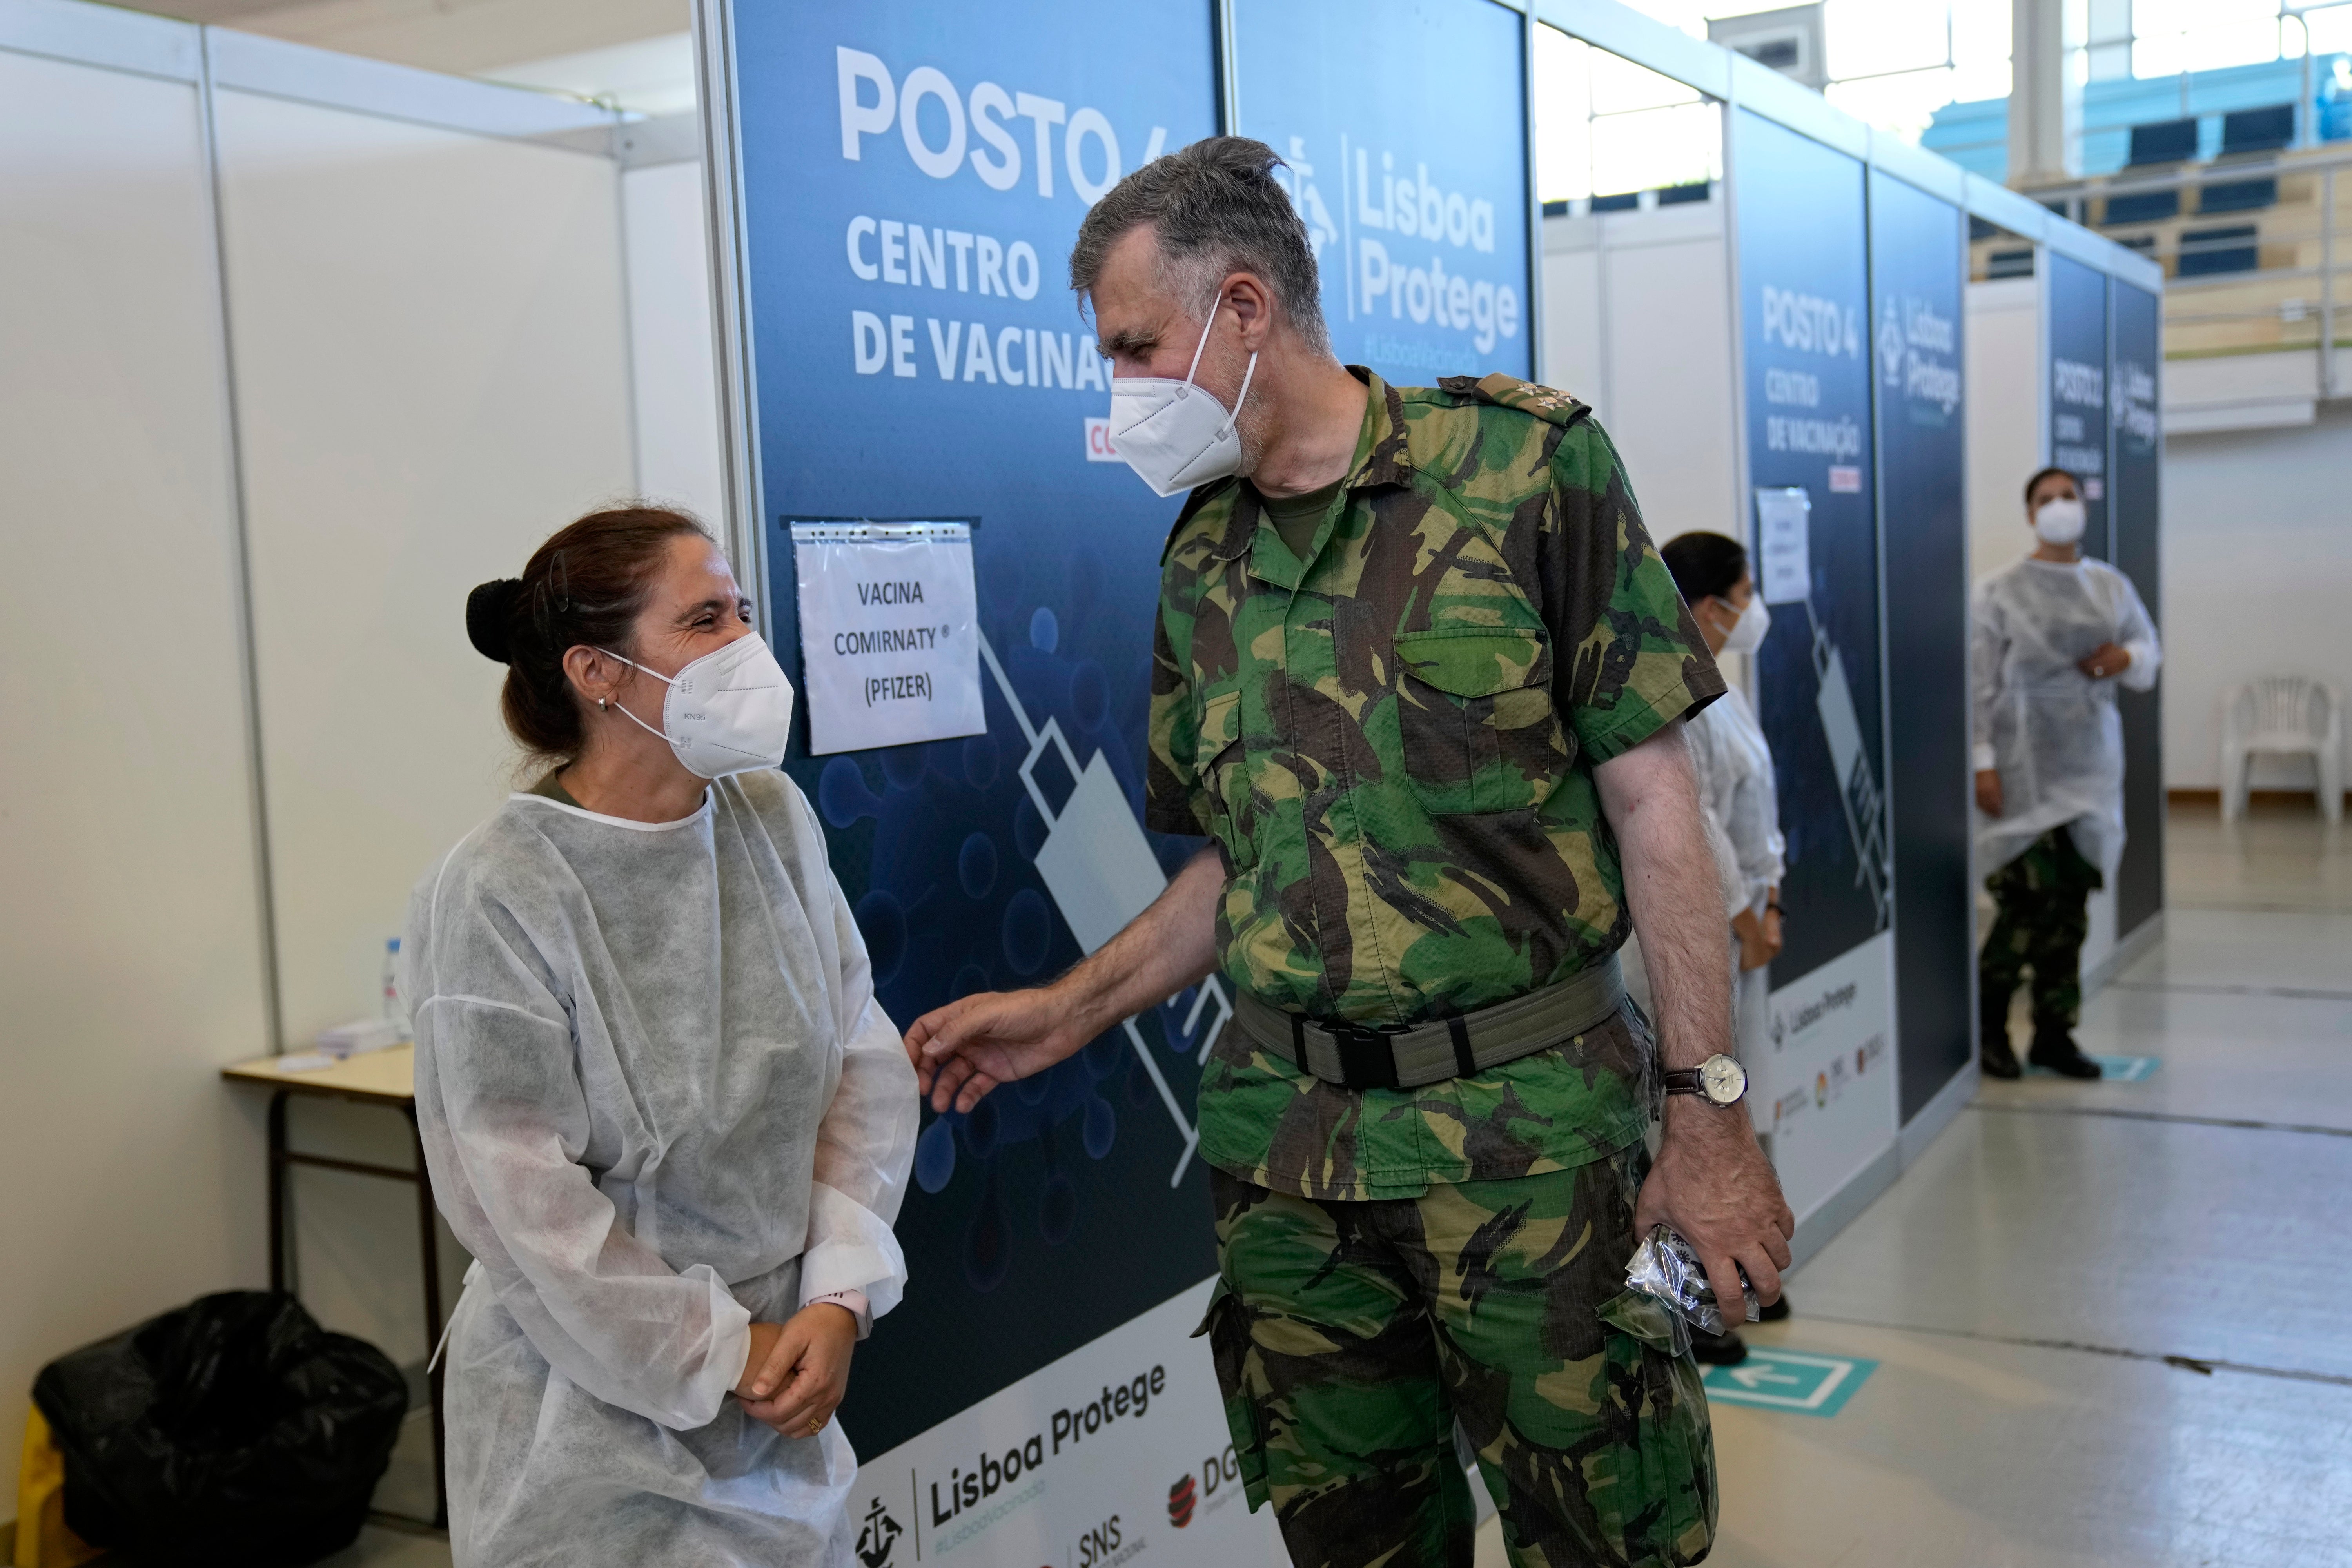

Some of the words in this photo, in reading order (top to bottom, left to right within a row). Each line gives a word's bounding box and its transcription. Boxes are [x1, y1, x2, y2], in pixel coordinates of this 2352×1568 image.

[837, 45, 1121, 209] POSTO
[1356, 147, 1495, 254] Lisboa
[846, 215, 1040, 301] CENTRO
[1358, 237, 1519, 354] Protege
[1763, 285, 1842, 358] POSTO
[852, 310, 917, 378] DE
[926, 318, 1114, 391] VACINA
[857, 581, 924, 606] VACINA
[834, 627, 936, 656] COMIRNATY
[684, 713, 706, 721] KN95
[865, 672, 932, 708] (PFIZER)
[930, 1432, 1043, 1528] Lisboa
[1051, 1364, 1165, 1456] Protege
[1203, 1442, 1238, 1497] DG
[1080, 1514, 1121, 1568] SNS
